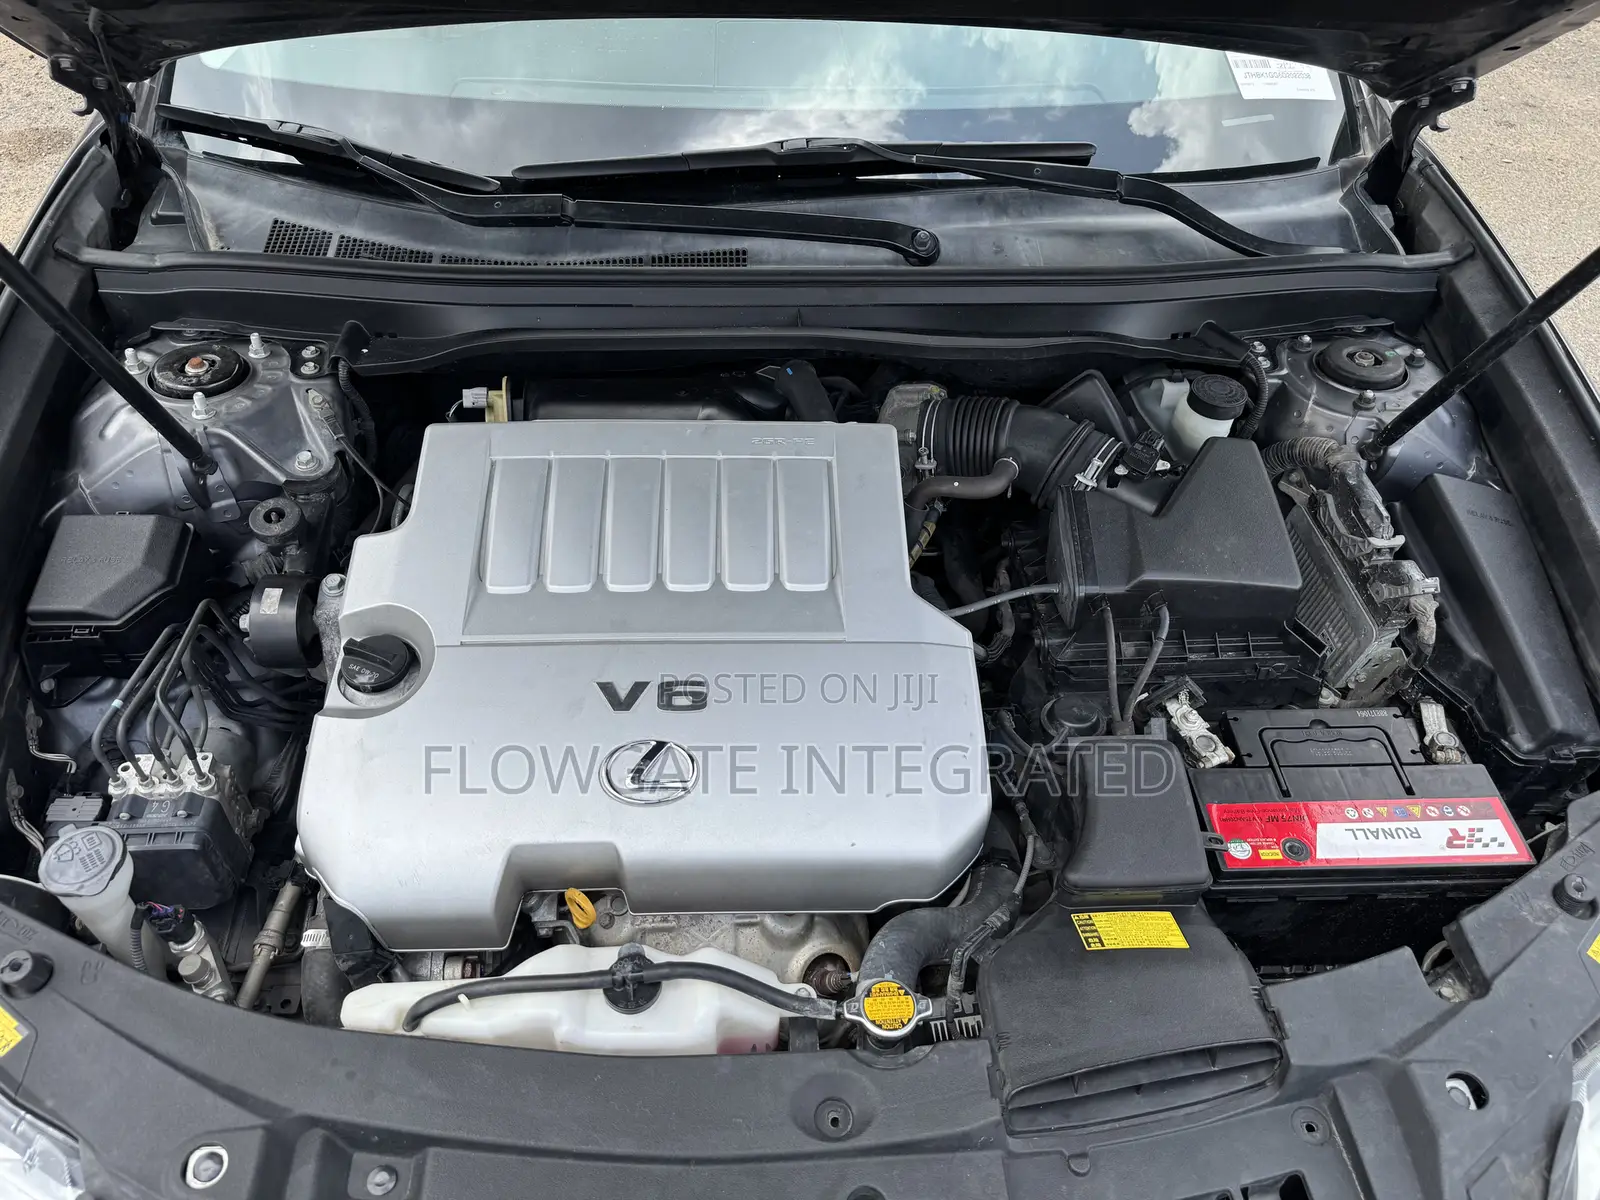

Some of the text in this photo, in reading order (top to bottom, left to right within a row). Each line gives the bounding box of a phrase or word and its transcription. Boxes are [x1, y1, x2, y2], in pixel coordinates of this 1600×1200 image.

[361, 667, 380, 679] 0W-20
[594, 680, 709, 712] V6
[1344, 826, 1422, 840] RUNALL
